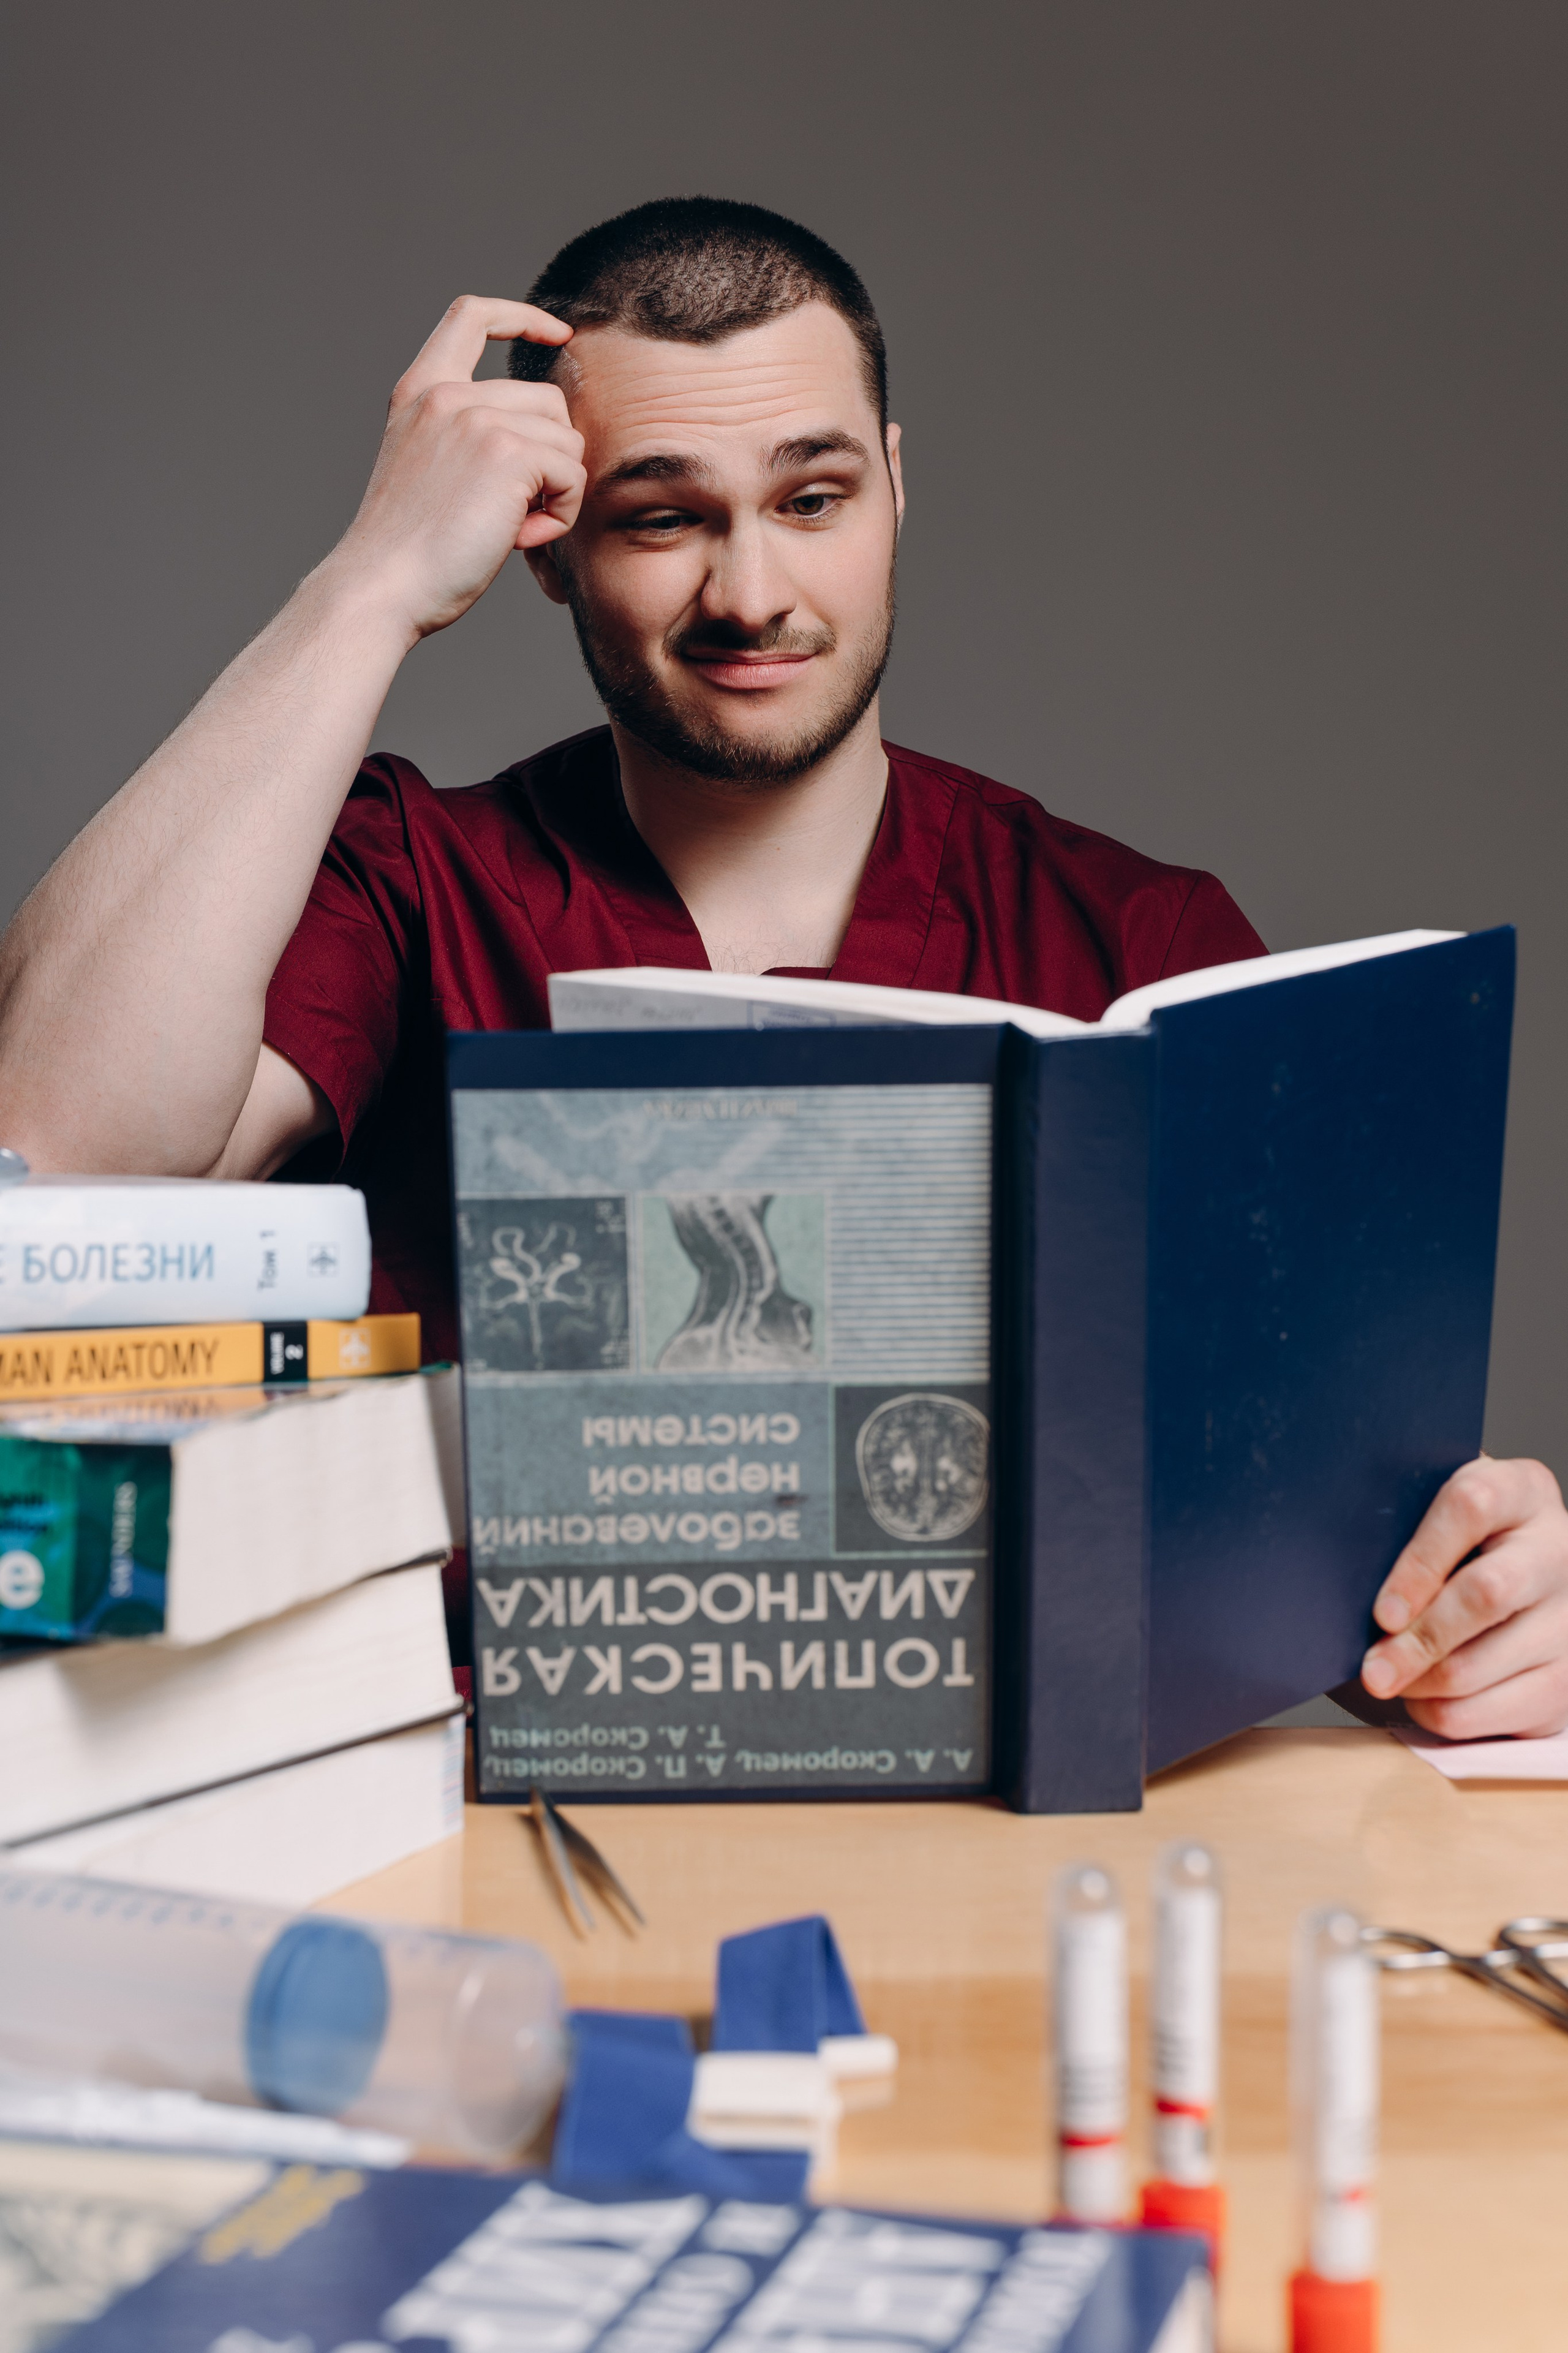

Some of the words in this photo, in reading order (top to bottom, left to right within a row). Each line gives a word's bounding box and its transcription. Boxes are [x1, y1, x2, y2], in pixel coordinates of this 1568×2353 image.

[259, 1229, 276, 1240] 1
[22, 1242, 215, 1284] БОЛЕЗНИ
[64, 1338, 220, 1383] ANATOMY
[285, 1344, 304, 1360] 2
[583, 1414, 799, 1446] системы
[589, 1455, 799, 1505] нервной
[472, 1511, 800, 1555] заболеваний
[477, 1569, 976, 1628] ДИАГНОСТИКА
[482, 1637, 974, 1696] ТОПИЧЕСКАЯ
[490, 1722, 650, 1751] Скоромец
